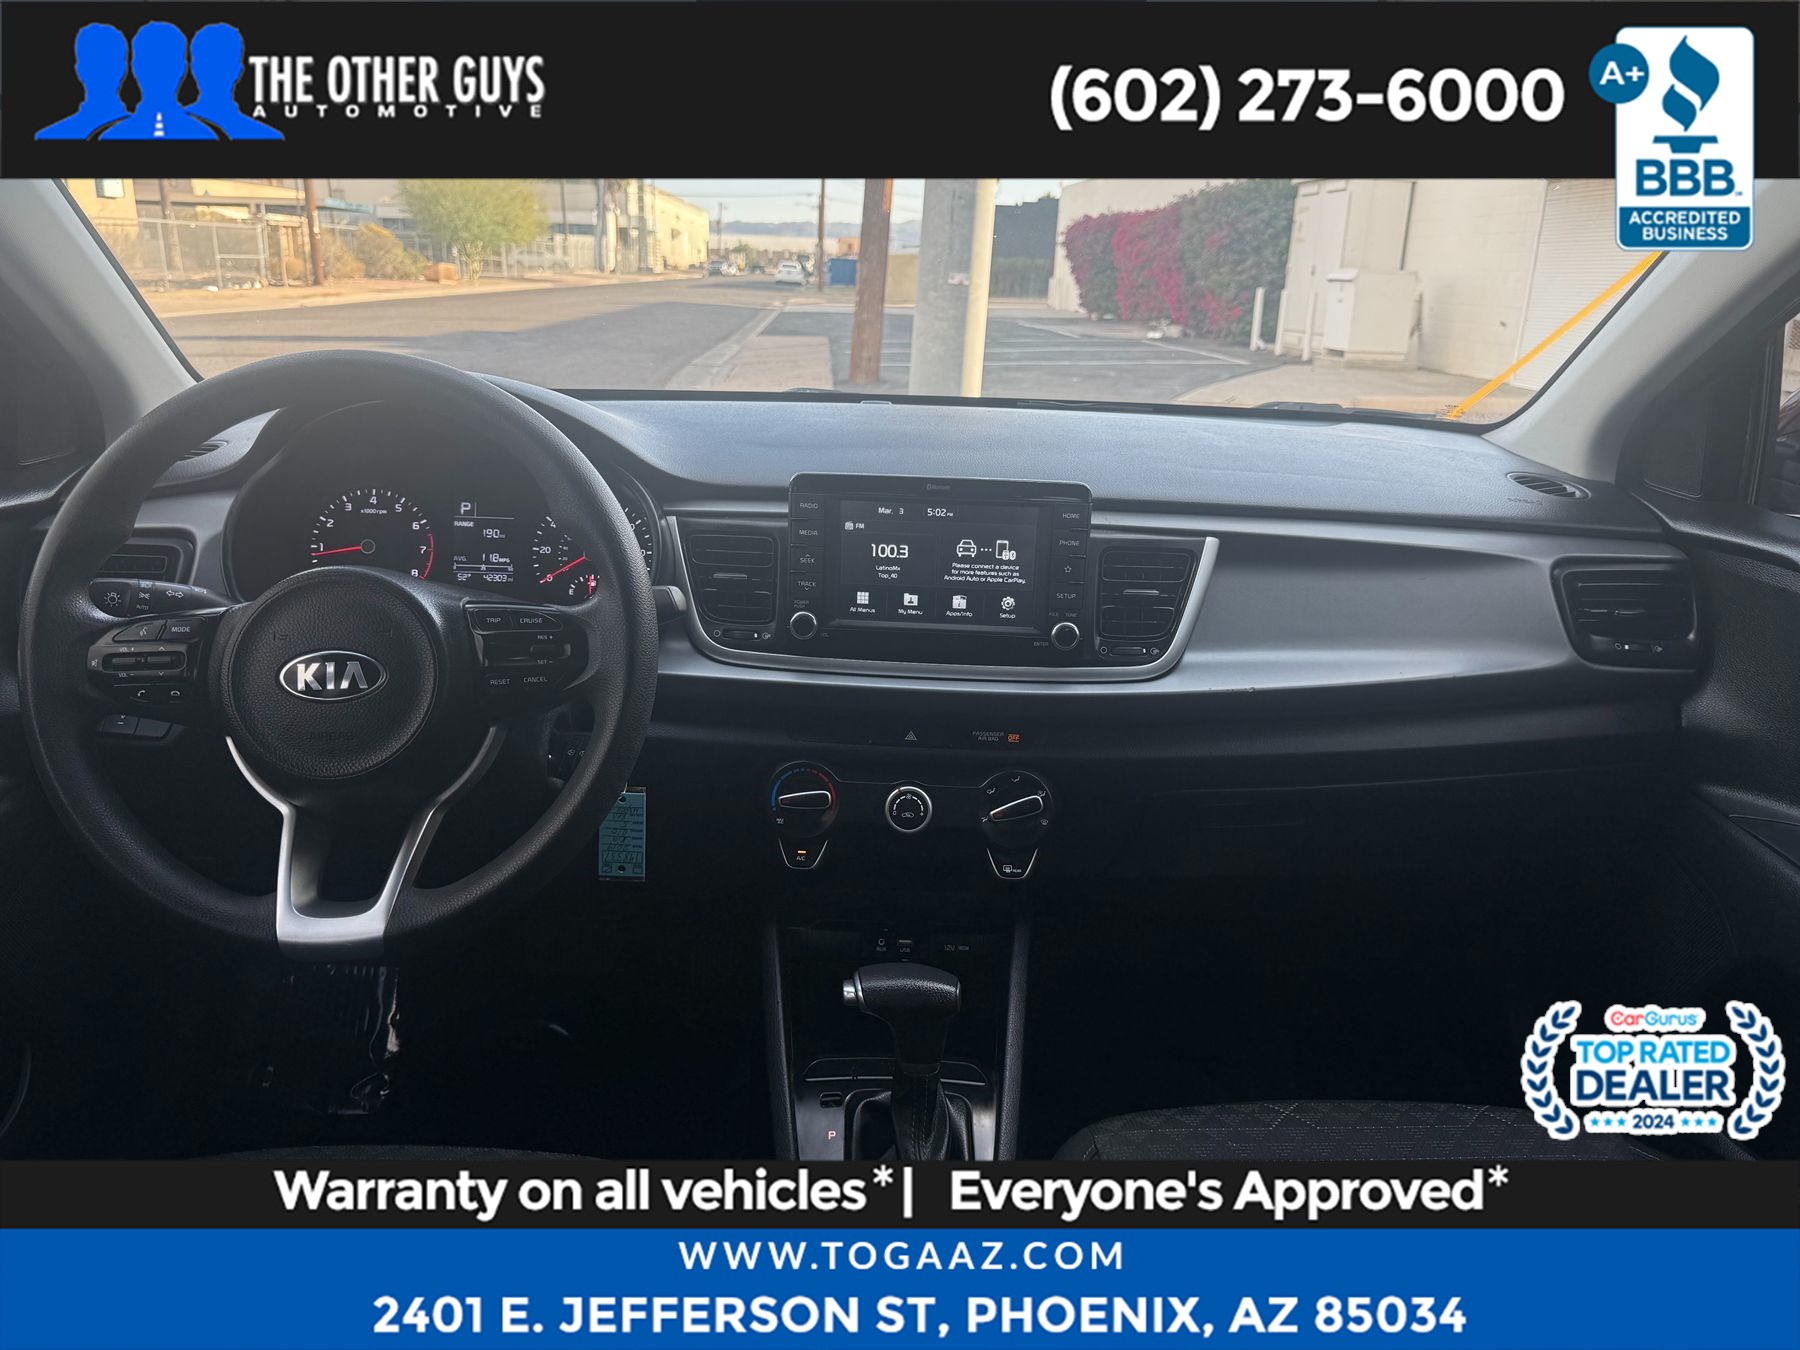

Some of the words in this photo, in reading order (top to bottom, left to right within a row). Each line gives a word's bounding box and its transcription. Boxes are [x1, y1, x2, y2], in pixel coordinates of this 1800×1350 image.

[370, 496, 377, 505] 4
[345, 503, 352, 511] 3
[395, 504, 402, 512] 5
[460, 502, 471, 515] P
[927, 509, 947, 517] 5:02
[326, 519, 334, 527] 2
[412, 522, 420, 530] 6
[319, 543, 324, 551] 1
[540, 546, 551, 554] 20
[871, 543, 909, 558] 100.3
[411, 569, 418, 577] 8
[296, 661, 368, 692] KIA
[1007, 733, 1020, 742] OFF
[828, 1131, 836, 1140] P
